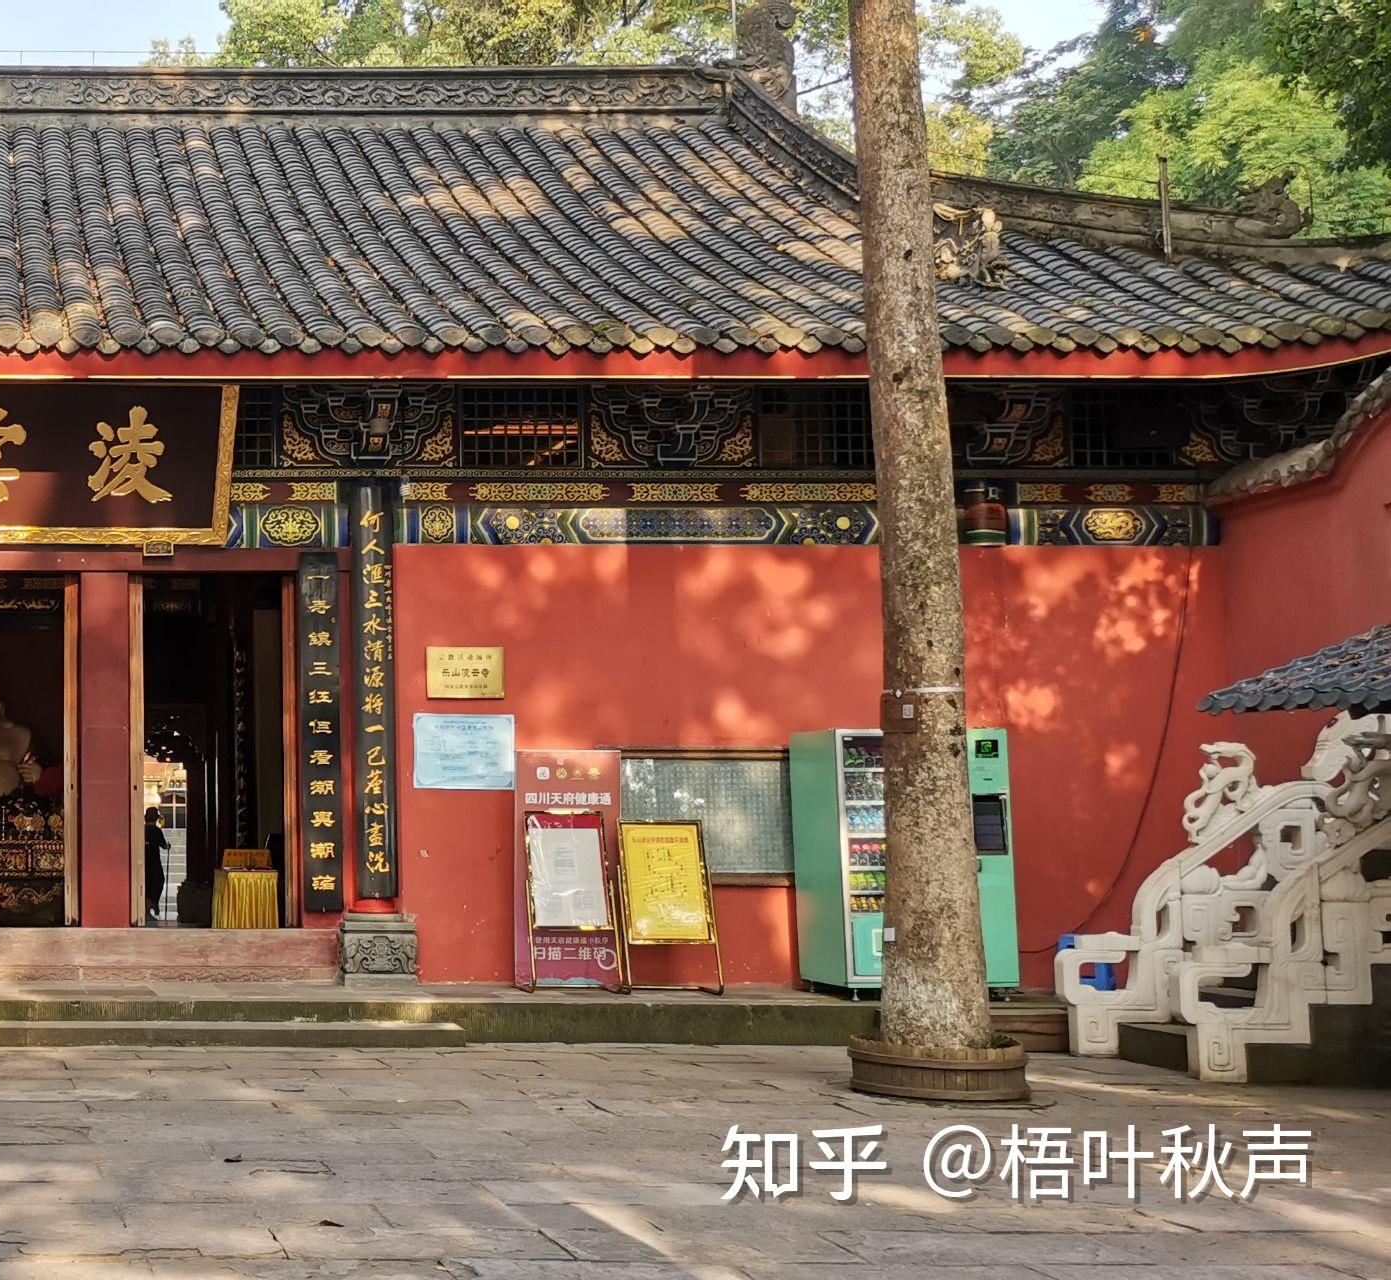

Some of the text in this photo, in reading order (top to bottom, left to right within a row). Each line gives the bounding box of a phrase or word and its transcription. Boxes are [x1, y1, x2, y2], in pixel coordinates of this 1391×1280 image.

[525, 792, 612, 806] 四川天府健康通
[528, 936, 609, 944] 使用天府健康通小程序
